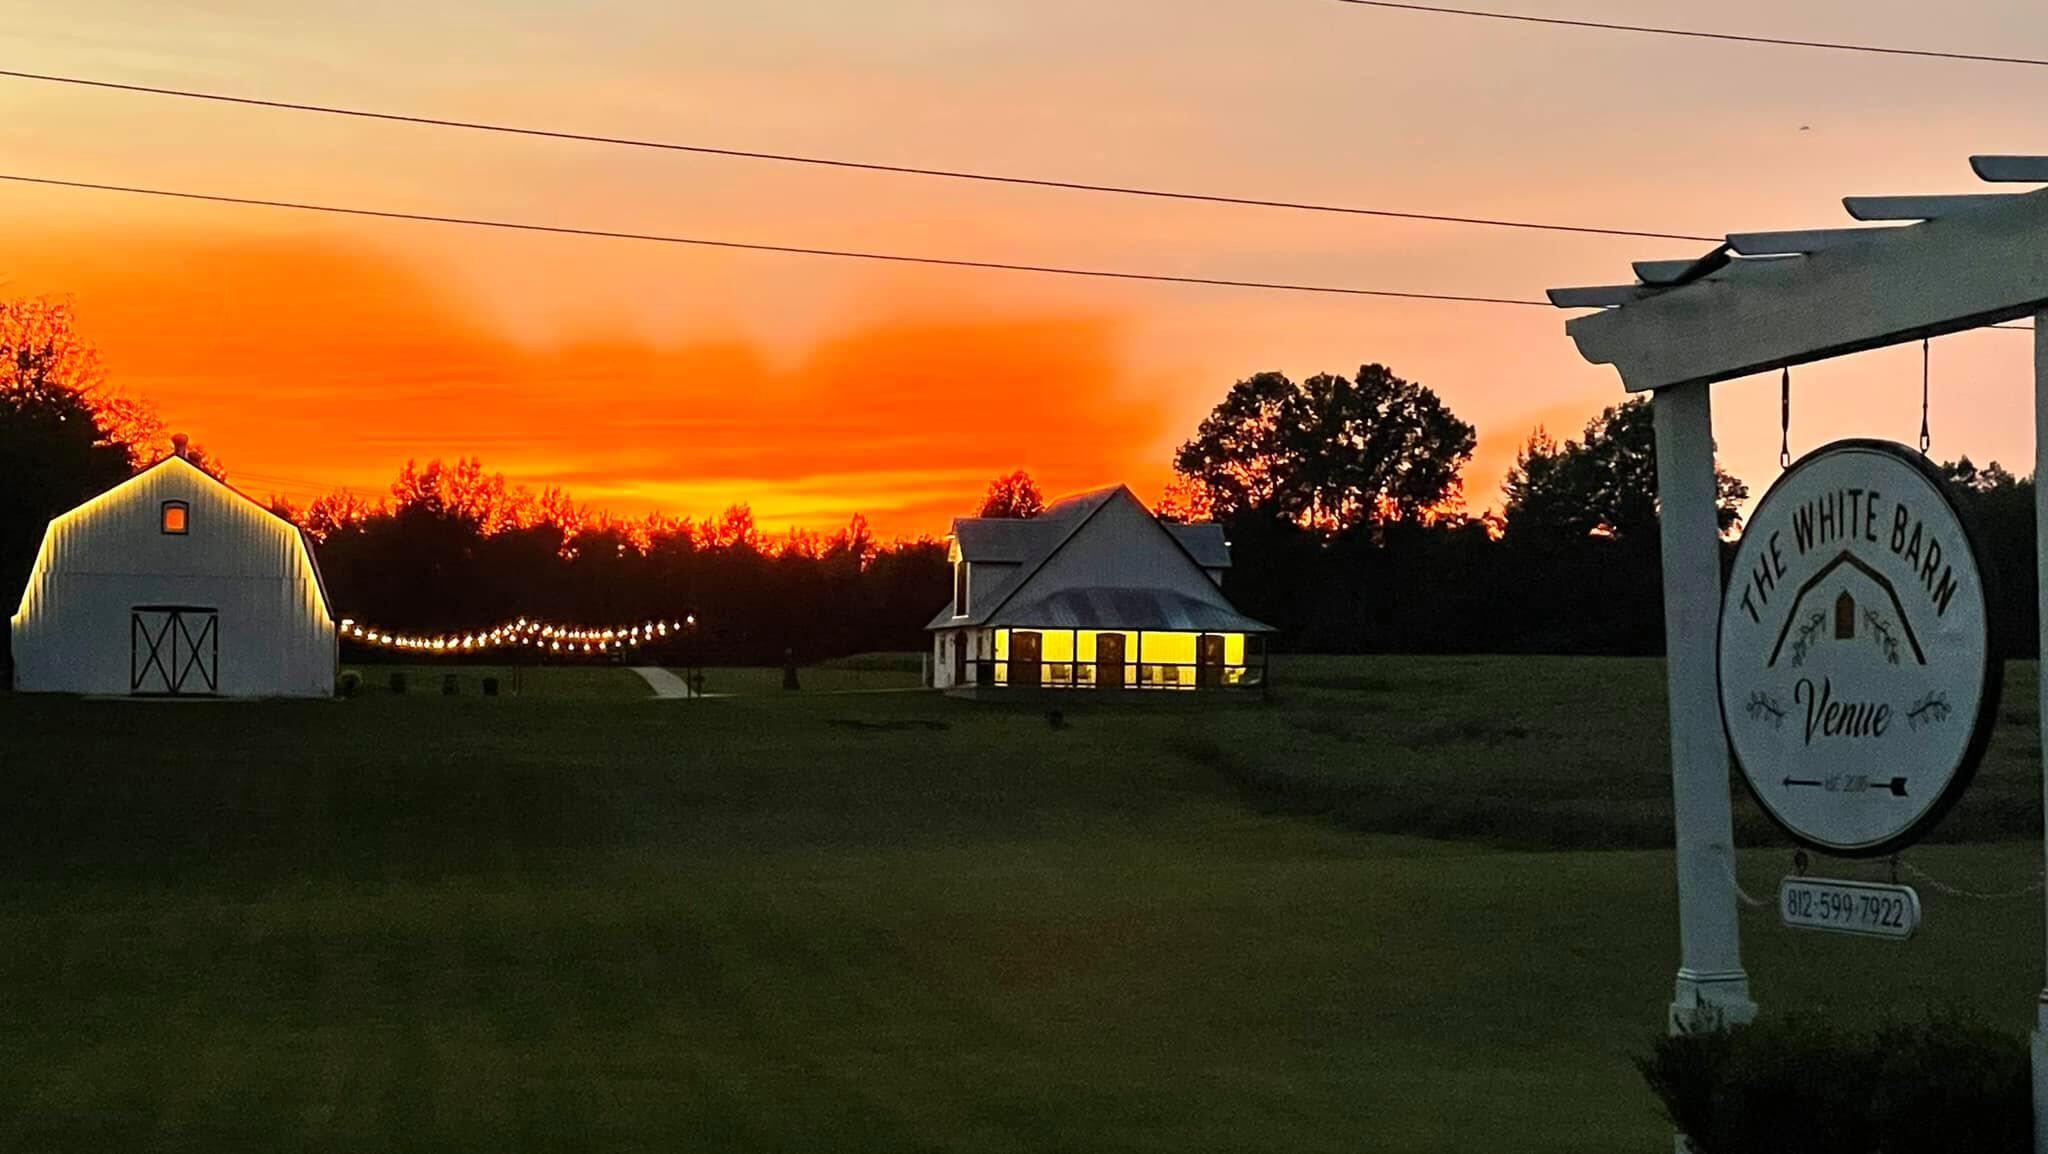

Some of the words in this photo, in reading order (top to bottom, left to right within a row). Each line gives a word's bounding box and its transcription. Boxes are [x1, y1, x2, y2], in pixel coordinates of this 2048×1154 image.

[1740, 530, 1787, 624] THE
[1793, 488, 1880, 555] WHITE
[1891, 502, 1958, 617] BARN
[1794, 675, 1892, 747] Venue
